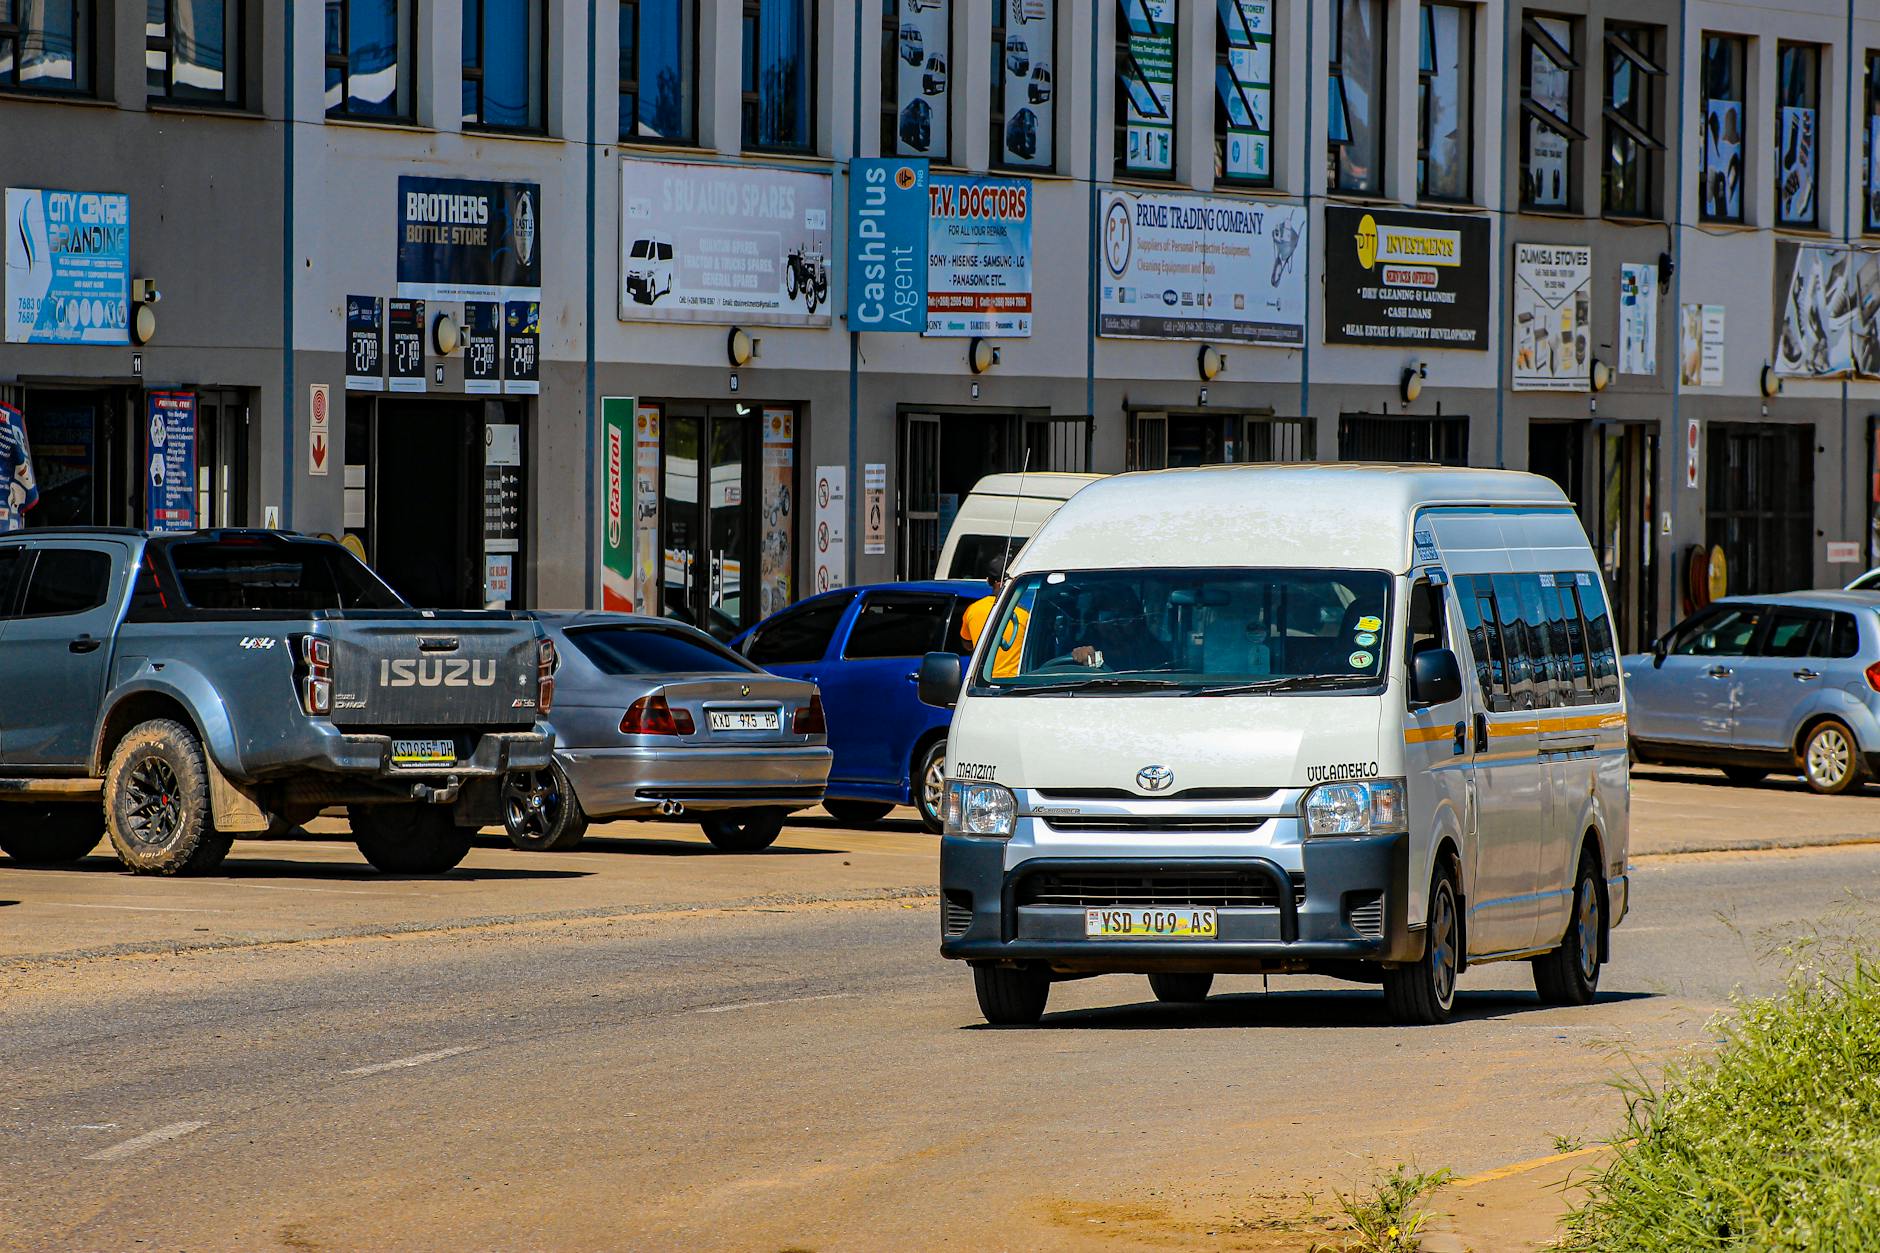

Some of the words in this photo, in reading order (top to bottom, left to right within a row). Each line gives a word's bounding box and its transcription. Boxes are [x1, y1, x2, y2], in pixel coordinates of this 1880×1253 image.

[49, 193, 77, 223] CITY
[79, 194, 127, 225] CENTRE
[406, 191, 490, 226] BROTHERS
[699, 182, 738, 217] AUTO
[741, 183, 796, 220] SPARES
[929, 186, 957, 220] T.V.
[958, 187, 1027, 222] DOCTORS
[1136, 202, 1168, 230] PRIME
[1169, 206, 1215, 234] TRADING
[1215, 209, 1265, 237] COMPANY
[406, 224, 450, 245] BOTTLE
[451, 227, 489, 247] STORE
[949, 225, 961, 236] FOR
[961, 226, 971, 236] ALL
[971, 227, 986, 237] YOUR
[858, 168, 887, 324] CashPlus
[1386, 234, 1455, 258] INVESTMENTS
[930, 255, 948, 268] SONY
[952, 255, 979, 268] HISENSE
[983, 256, 1012, 268] SAMSUNG
[1016, 256, 1026, 268] LG
[1520, 248, 1553, 266] DUMISA
[1554, 250, 1589, 267] STOVES
[890, 245, 918, 325] Agent
[952, 273, 991, 287] PANASONIC
[18, 297, 35, 311] 7683
[1362, 288, 1378, 300] DRY
[1378, 289, 1415, 302] CLEANING
[1423, 292, 1458, 304] LAUNDRY
[1387, 307, 1407, 319] CASH
[1407, 309, 1432, 321] LOANS
[1345, 324, 1365, 336] REAL
[1365, 325, 1390, 338] ESTATE
[1396, 327, 1430, 340] PROPERTY
[1430, 328, 1478, 342] DEVELOPMENT
[609, 433, 621, 518] Castrol
[380, 659, 497, 687] ISUZU
[712, 713, 731, 728] KXD
[739, 713, 758, 728] 975
[765, 713, 777, 728] HP
[440, 741, 454, 757] DH
[956, 762, 997, 781] MANZINI
[1102, 911, 1133, 933] YSD
[1142, 911, 1178, 933] 909
[1191, 911, 1213, 933] AS
